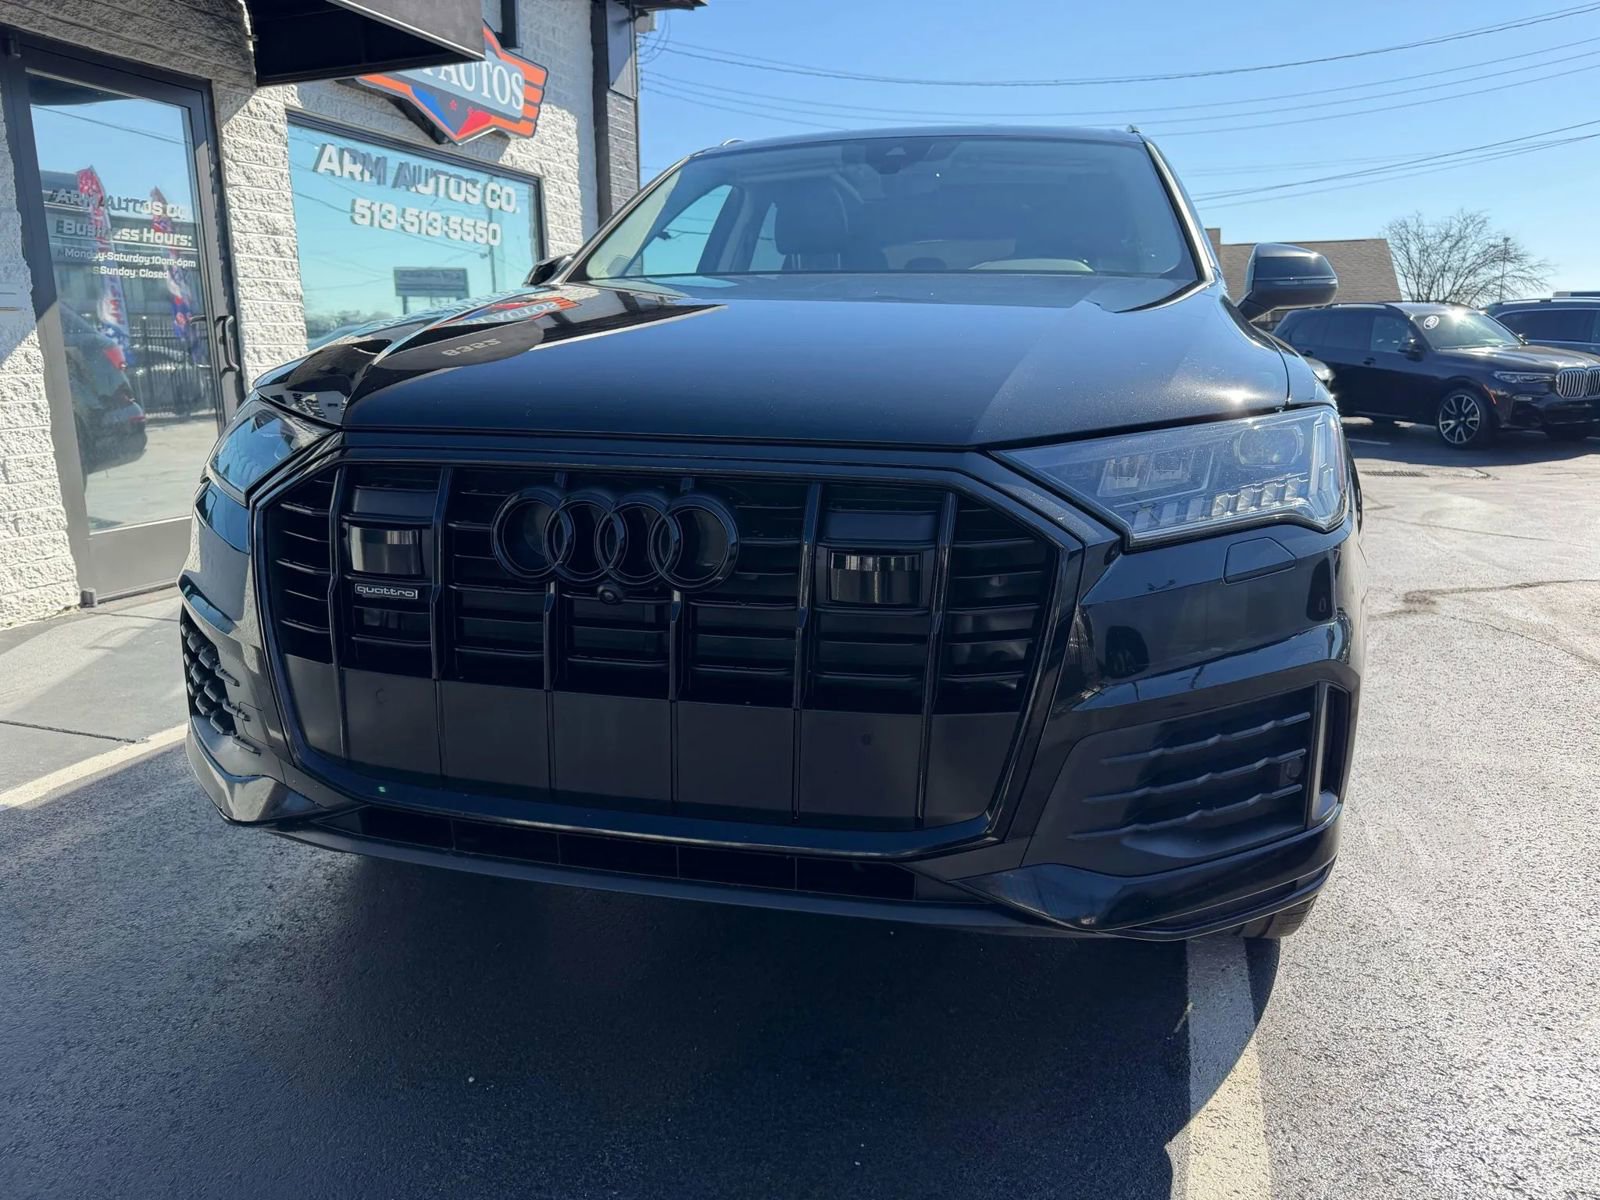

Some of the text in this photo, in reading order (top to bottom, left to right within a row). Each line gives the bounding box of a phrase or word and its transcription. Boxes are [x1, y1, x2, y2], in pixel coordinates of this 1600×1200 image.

[314, 143, 387, 186] ARM
[392, 162, 482, 205] AUTOS
[352, 197, 501, 246] 513-513-5550
[139, 267, 169, 279] Closed
[356, 586, 415, 598] quattro
